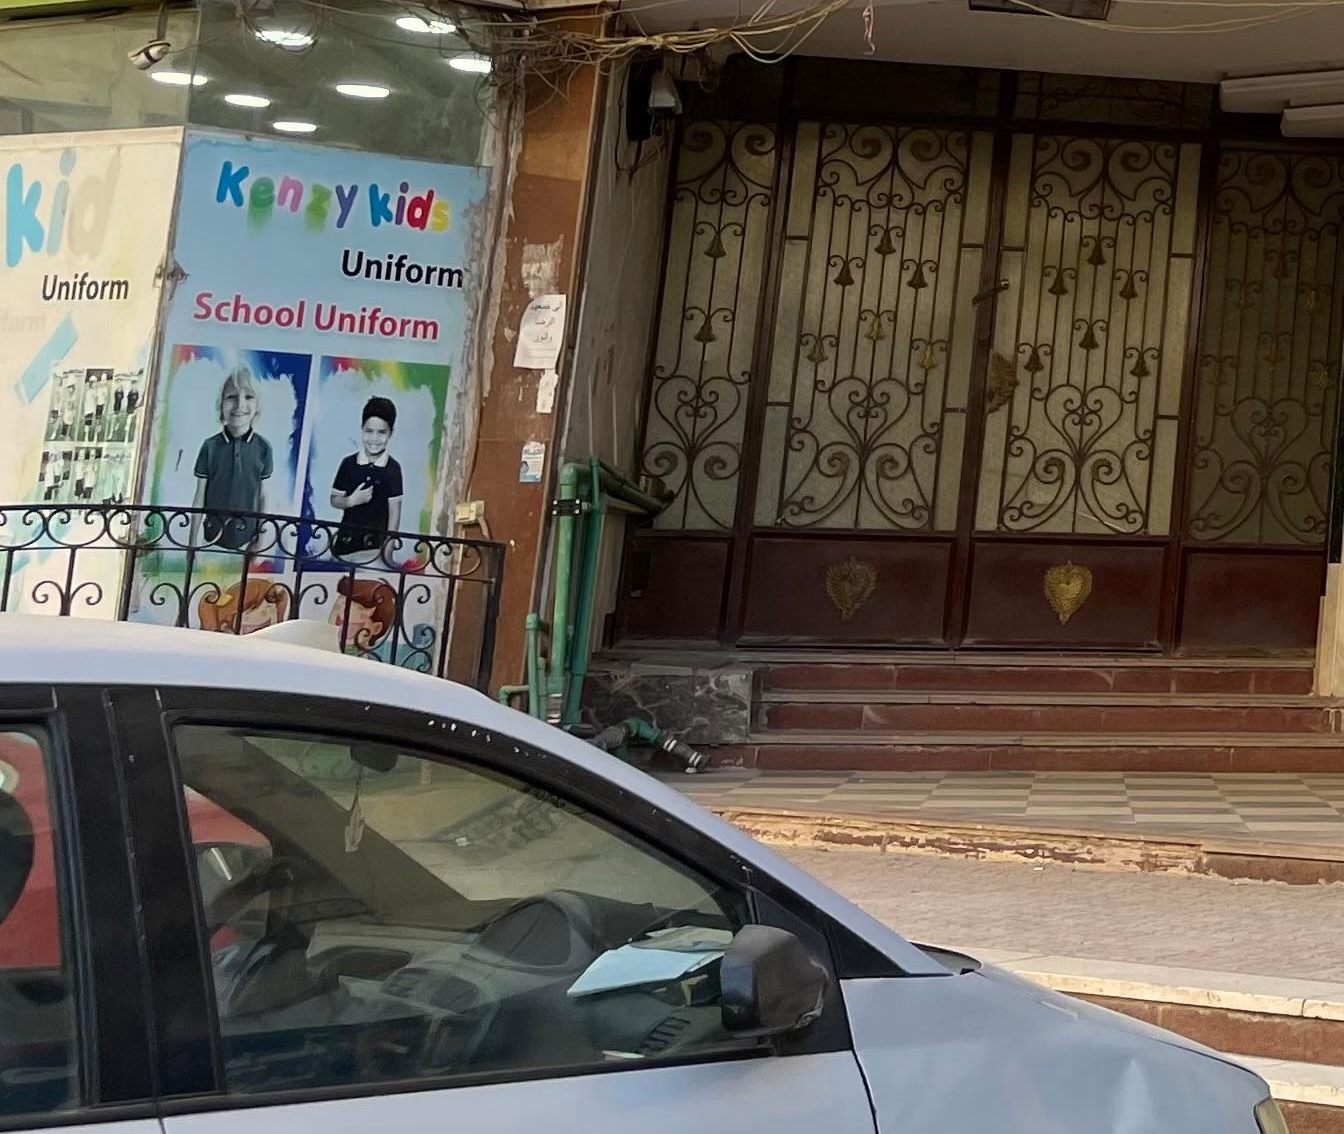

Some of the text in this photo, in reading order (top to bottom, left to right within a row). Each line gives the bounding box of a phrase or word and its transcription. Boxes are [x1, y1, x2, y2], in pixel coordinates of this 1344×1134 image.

[216, 160, 449, 233] Kenzy kids
[42, 272, 129, 301] Uniform
[342, 249, 463, 288] Uniform
[193, 292, 439, 340] School Uniform
